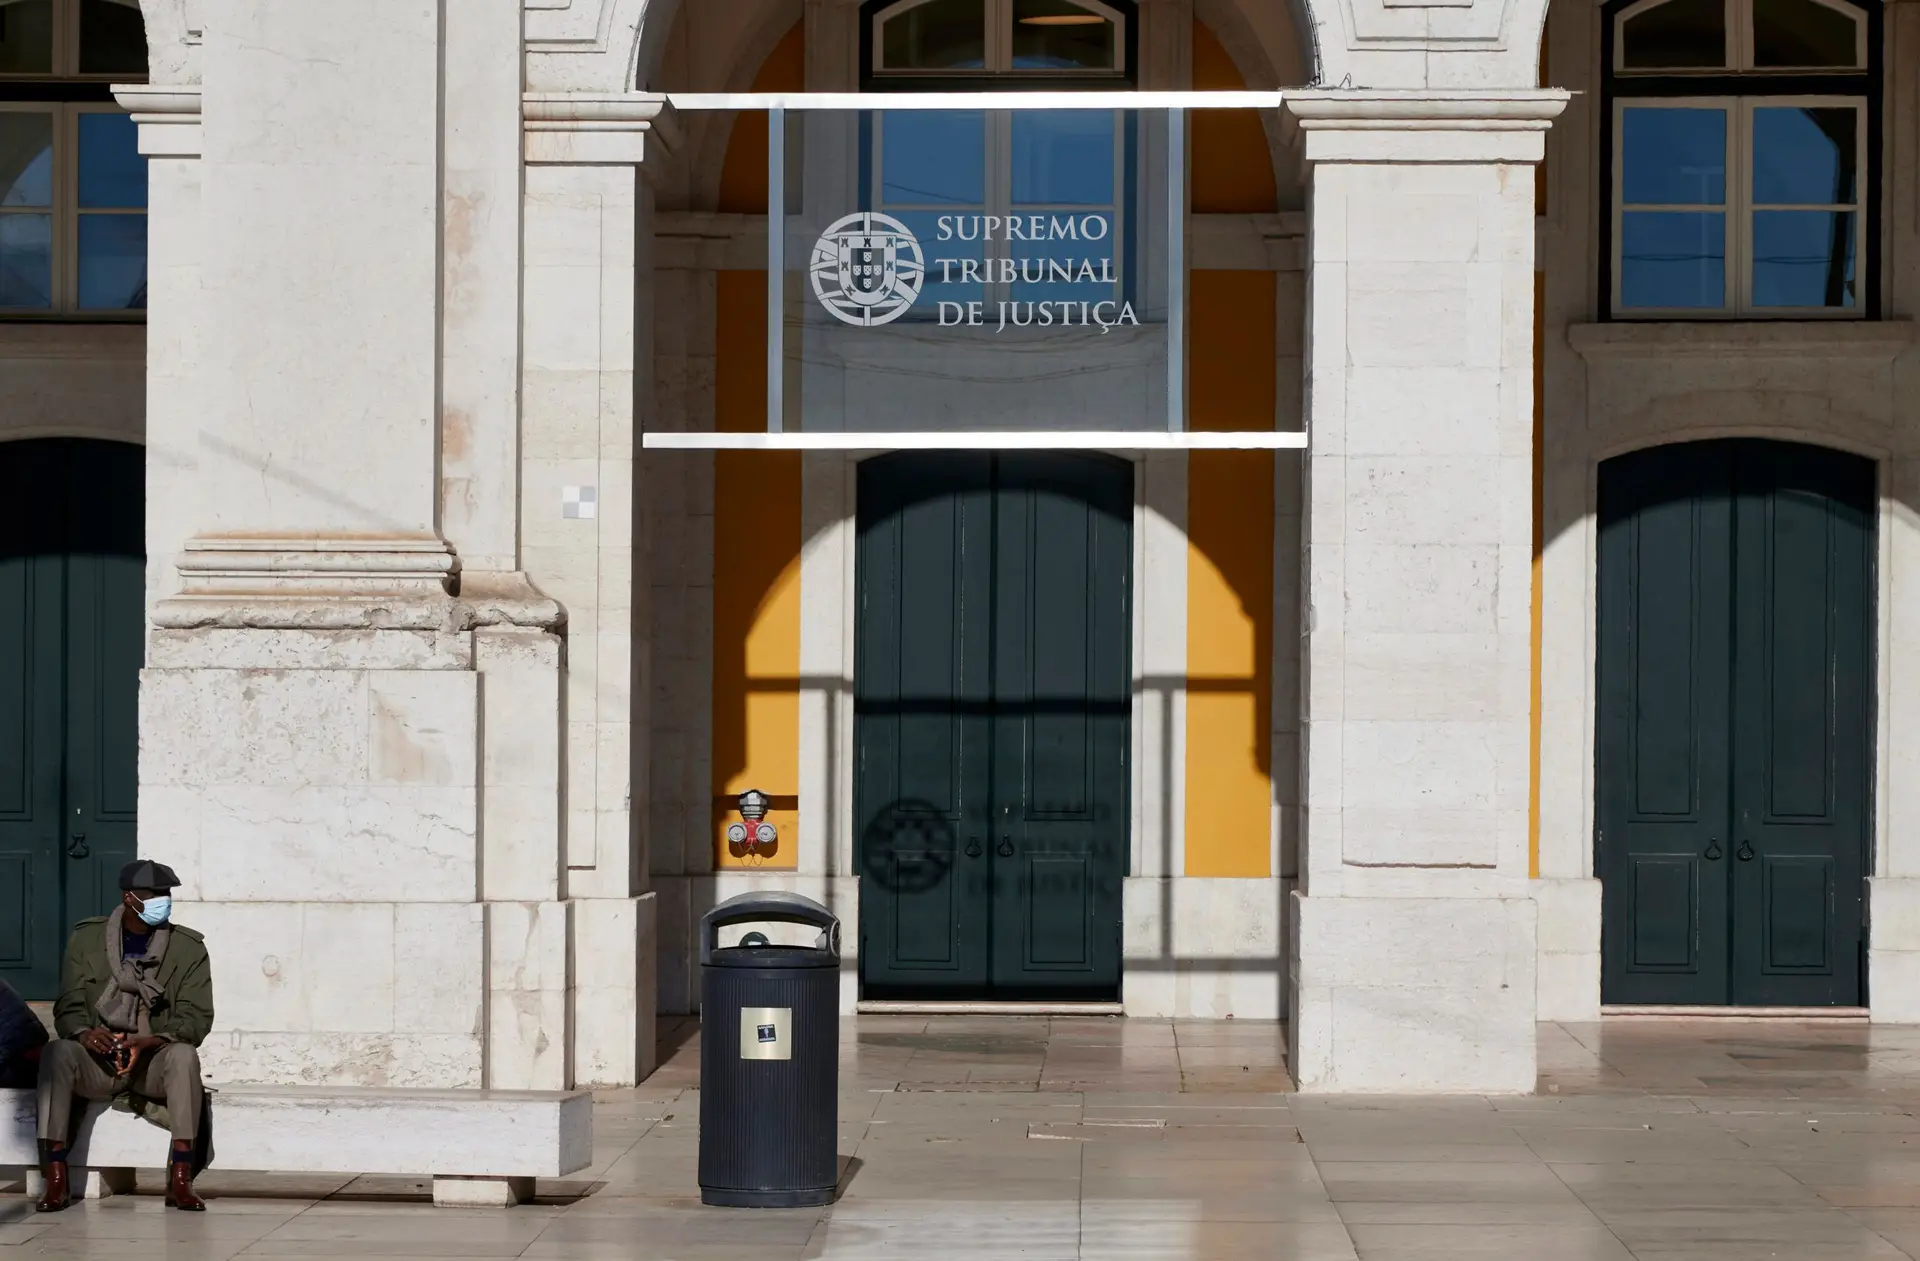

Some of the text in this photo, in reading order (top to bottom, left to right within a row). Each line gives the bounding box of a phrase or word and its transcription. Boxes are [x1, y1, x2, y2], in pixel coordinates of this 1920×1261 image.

[936, 215, 1108, 241] SUPREMO
[935, 258, 1118, 284] TRIBUNAL
[936, 301, 1141, 335] DE JUSTIÇA
